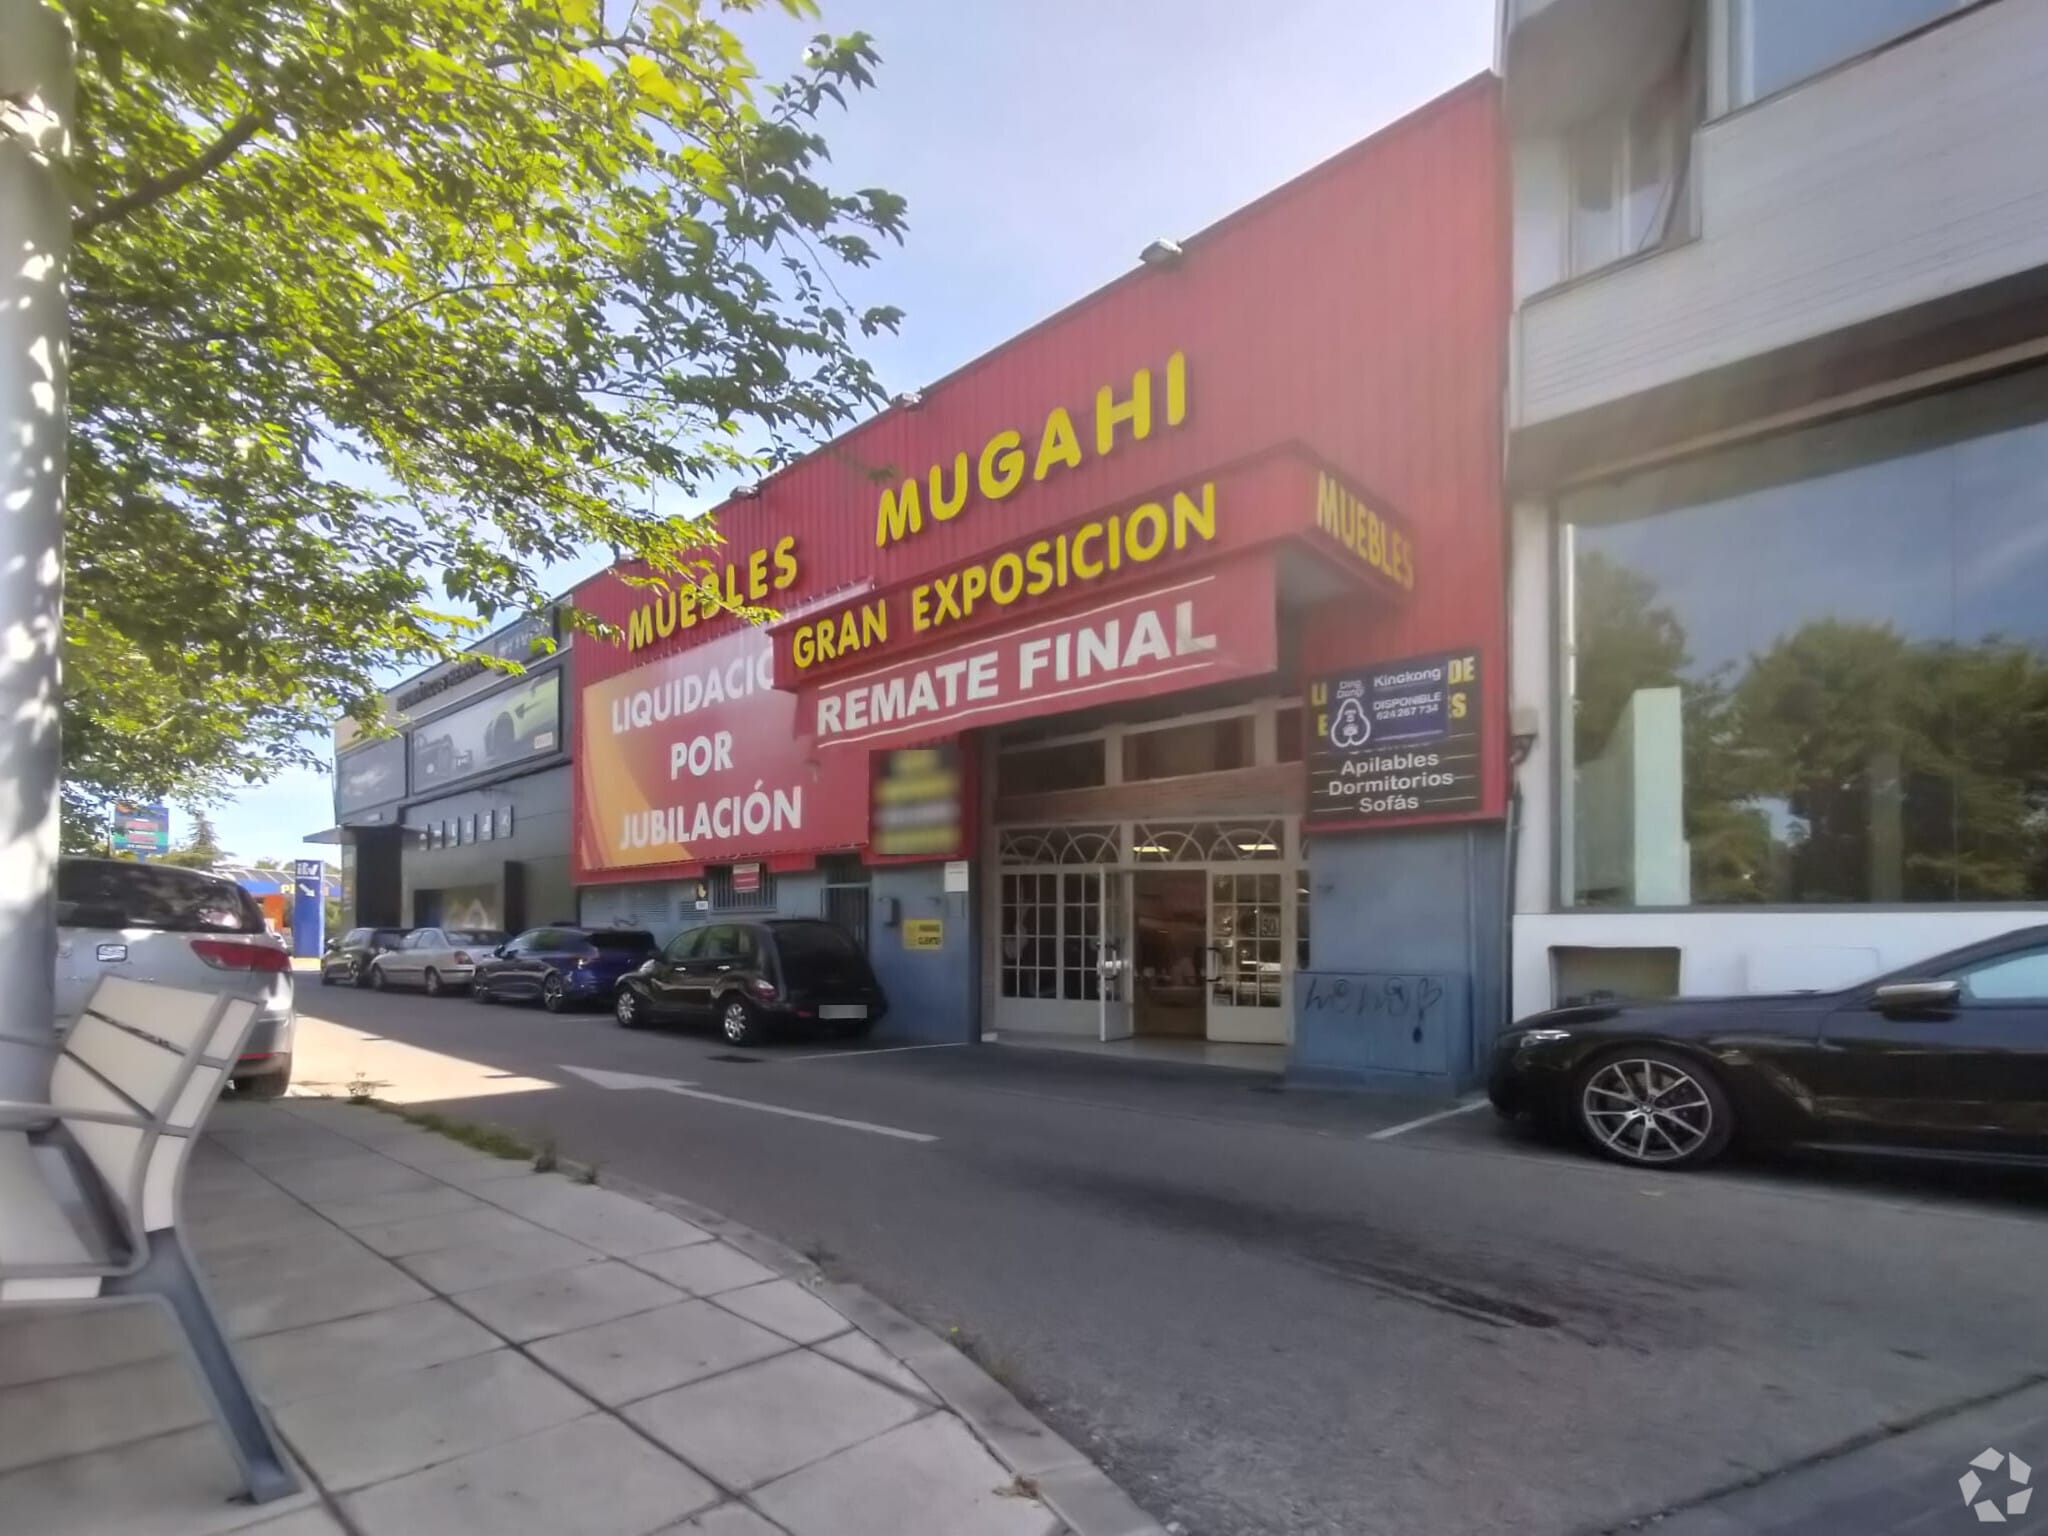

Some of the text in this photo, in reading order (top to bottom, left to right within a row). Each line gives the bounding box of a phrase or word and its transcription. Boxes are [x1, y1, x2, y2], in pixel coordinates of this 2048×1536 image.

[628, 350, 1187, 652] MUEBLES MUGAHI
[1316, 469, 1415, 592] MUEBLES
[792, 481, 1216, 669] GRAN EXPOSICION
[817, 600, 1217, 736] REMATE FINAL
[1372, 691, 1443, 711] DISPONIBLE
[670, 730, 734, 781] POR
[1328, 772, 1455, 796] Dormitorios
[1340, 753, 1440, 777] Apilables
[619, 779, 803, 851] JUBILACIÓN
[1358, 793, 1420, 813] Sofás
